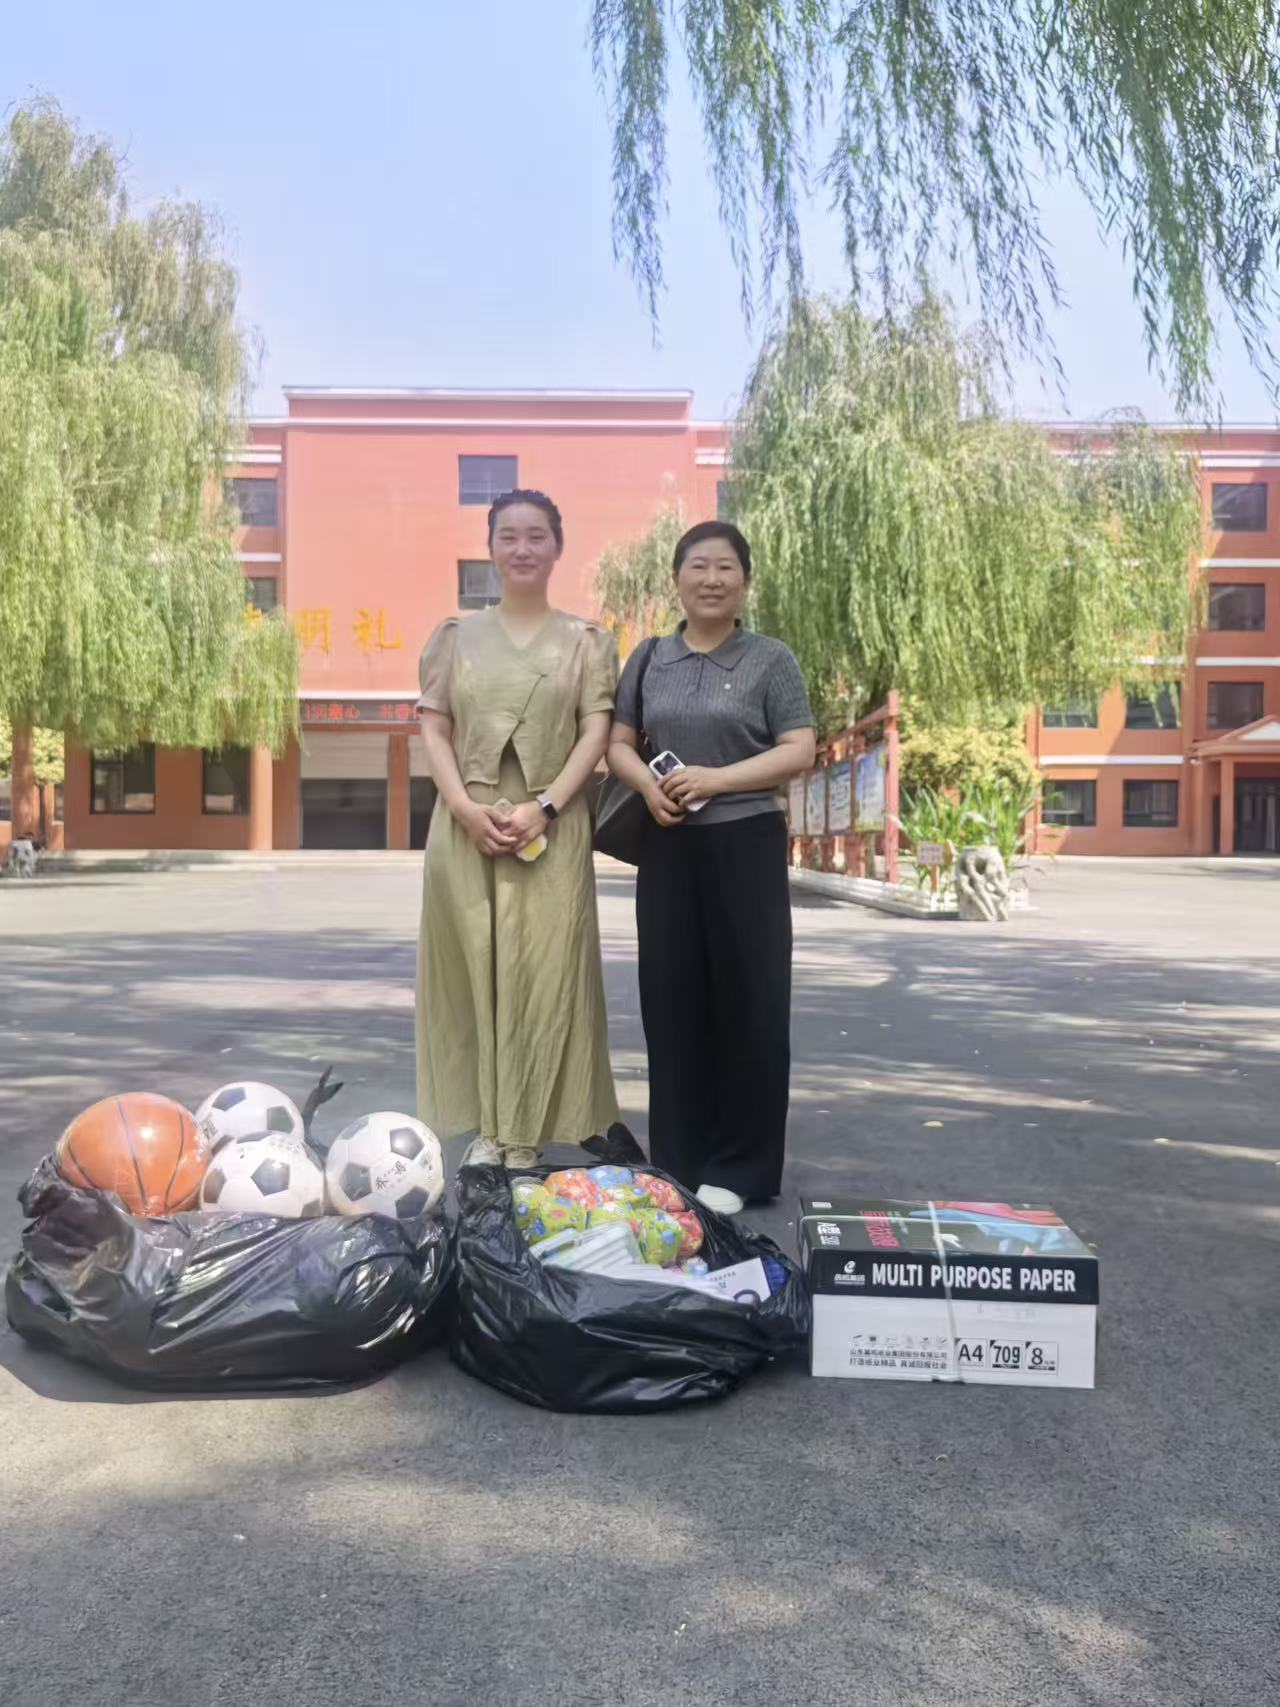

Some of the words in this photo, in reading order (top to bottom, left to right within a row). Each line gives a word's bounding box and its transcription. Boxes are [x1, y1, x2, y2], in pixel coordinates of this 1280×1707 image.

[872, 1262, 923, 1287] MULTI
[930, 1264, 1012, 1290] PURPOSE
[1019, 1267, 1076, 1293] PAPER
[958, 1343, 984, 1362] A4
[1031, 1347, 1044, 1366] 8
